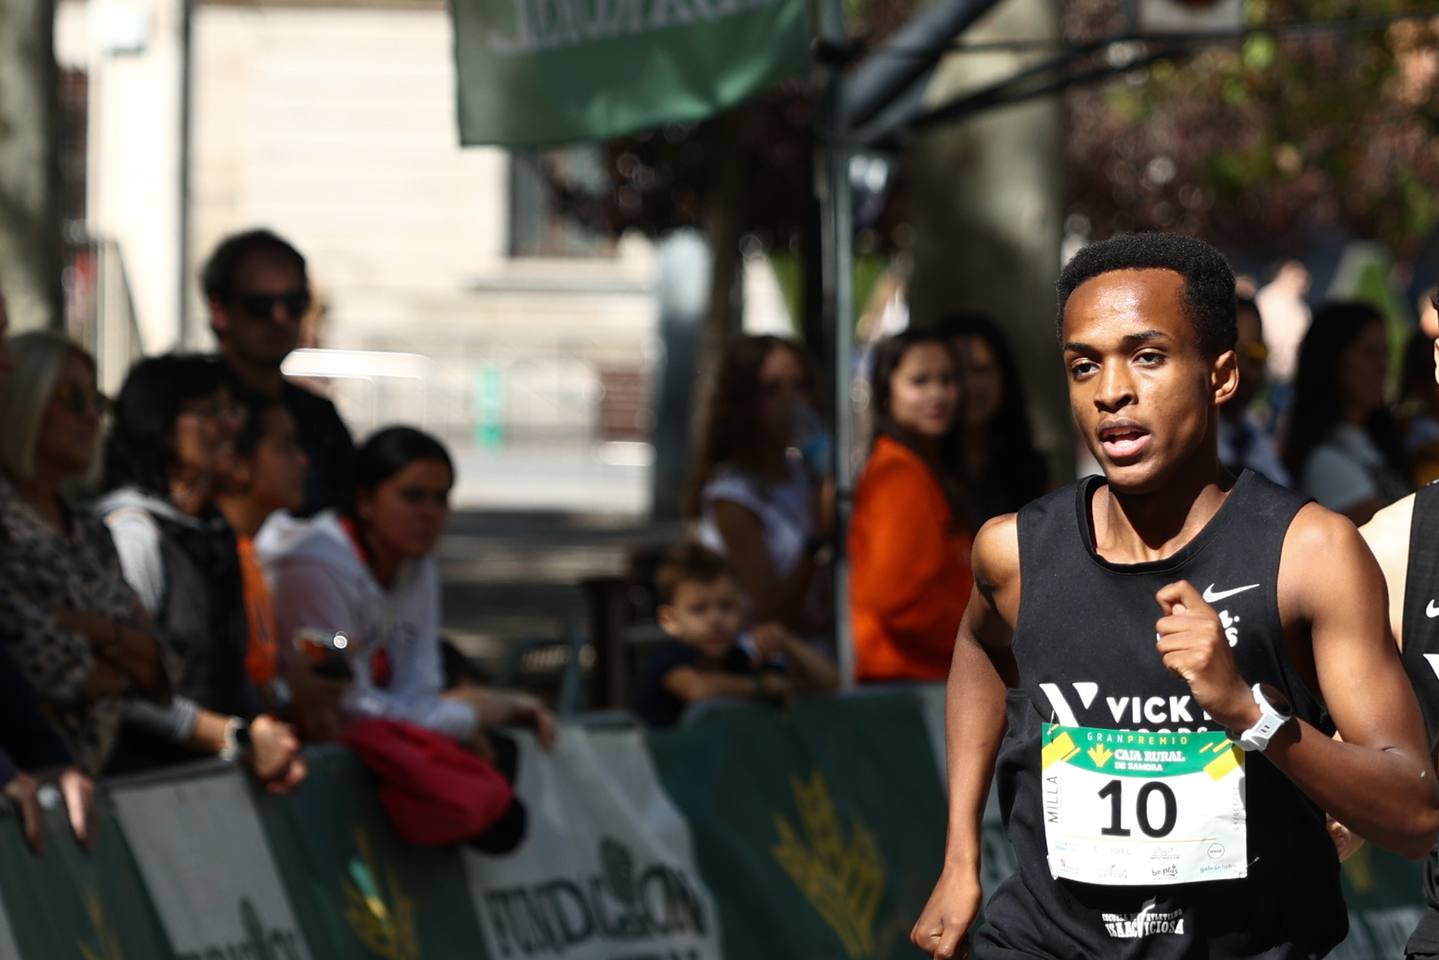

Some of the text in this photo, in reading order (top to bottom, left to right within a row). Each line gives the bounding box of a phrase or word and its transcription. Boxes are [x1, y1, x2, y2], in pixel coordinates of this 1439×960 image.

[1105, 696, 1212, 724] VICK
[1114, 749, 1185, 762] CAJA RURAL
[1114, 762, 1126, 770] DE
[1047, 775, 1058, 823] MILLA
[1097, 779, 1178, 838] 10
